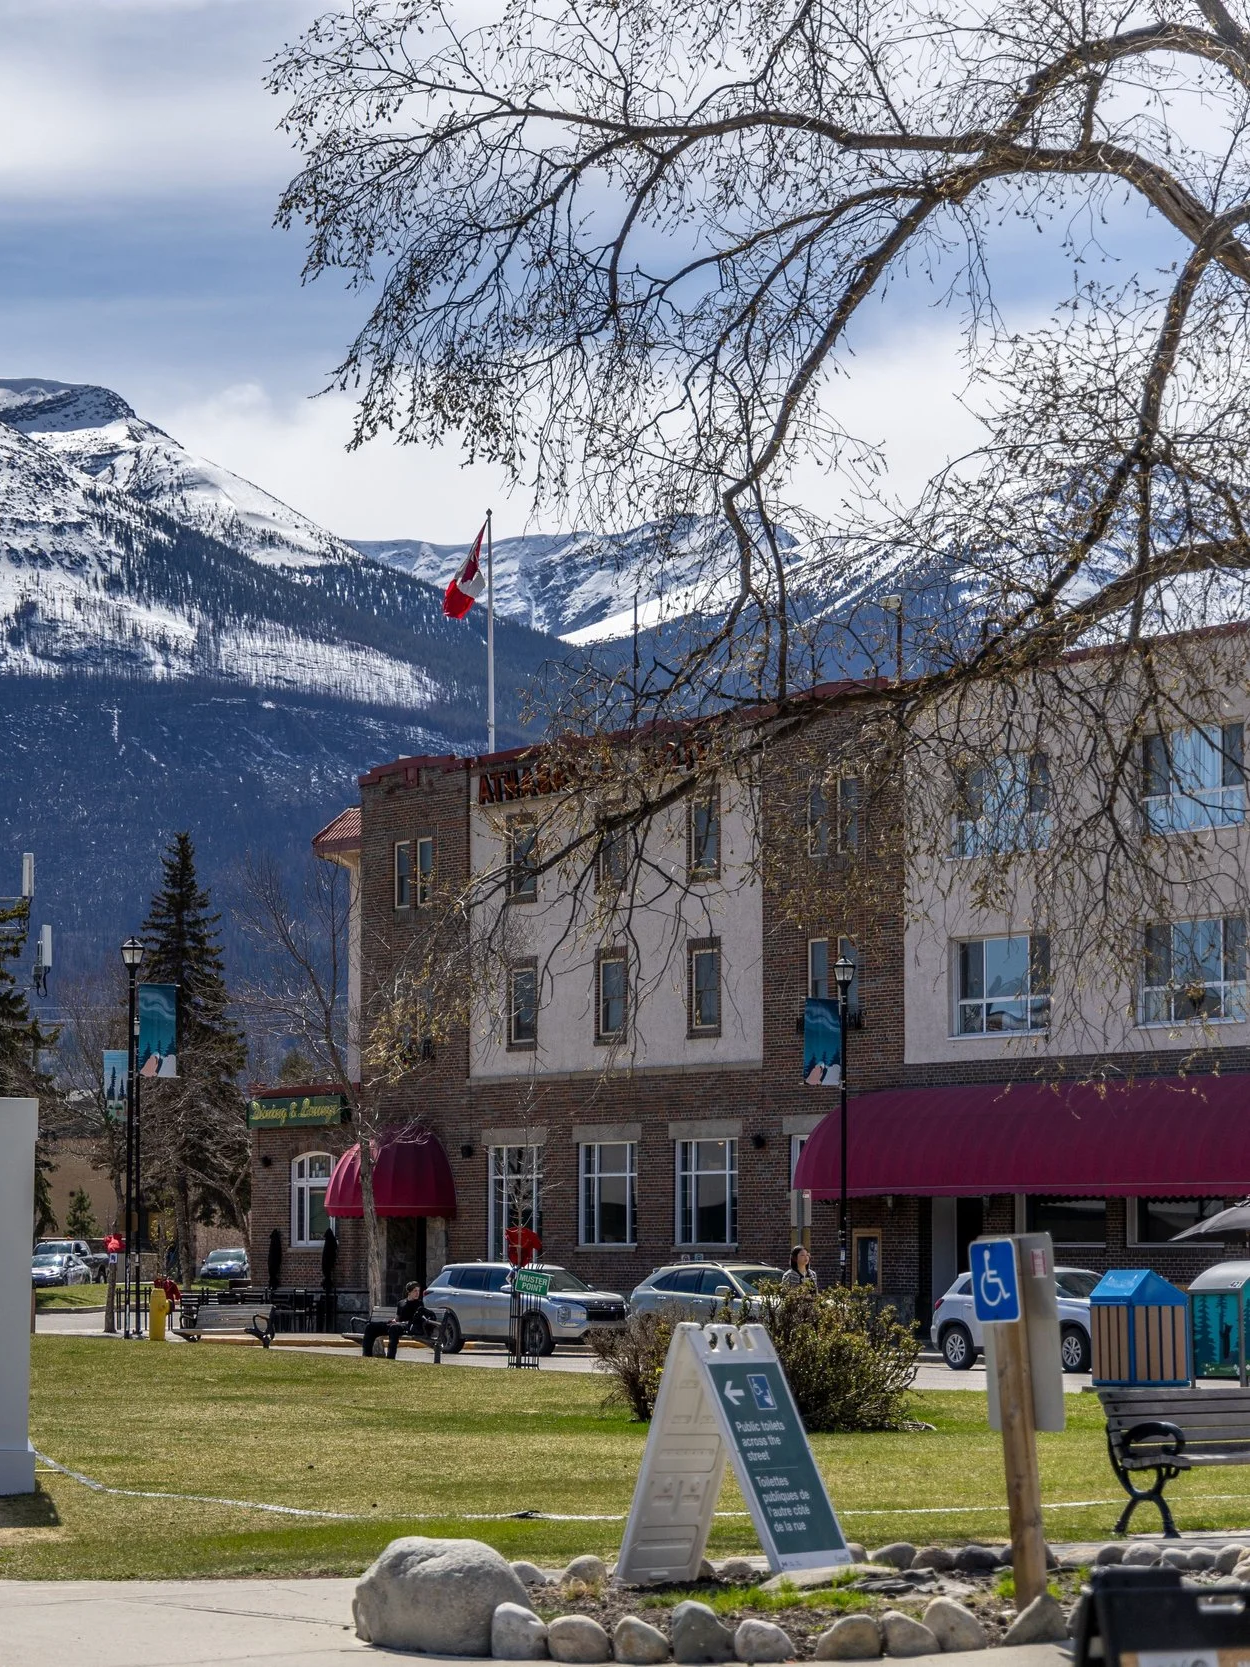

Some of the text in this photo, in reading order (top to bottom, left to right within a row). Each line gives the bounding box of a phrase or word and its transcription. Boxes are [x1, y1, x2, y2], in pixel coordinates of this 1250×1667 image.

[251, 1101, 287, 1126] Dining
[519, 1274, 547, 1286] MUSTER
[522, 1282, 543, 1292] POINT
[735, 1420, 786, 1432] Public toilets
[742, 1435, 781, 1447] across the
[747, 1451, 770, 1462] street
[755, 1476, 789, 1488] Toilettes
[762, 1489, 810, 1504] publiques de
[767, 1504, 811, 1517] l'autre côté
[774, 1521, 806, 1533] de la rue
